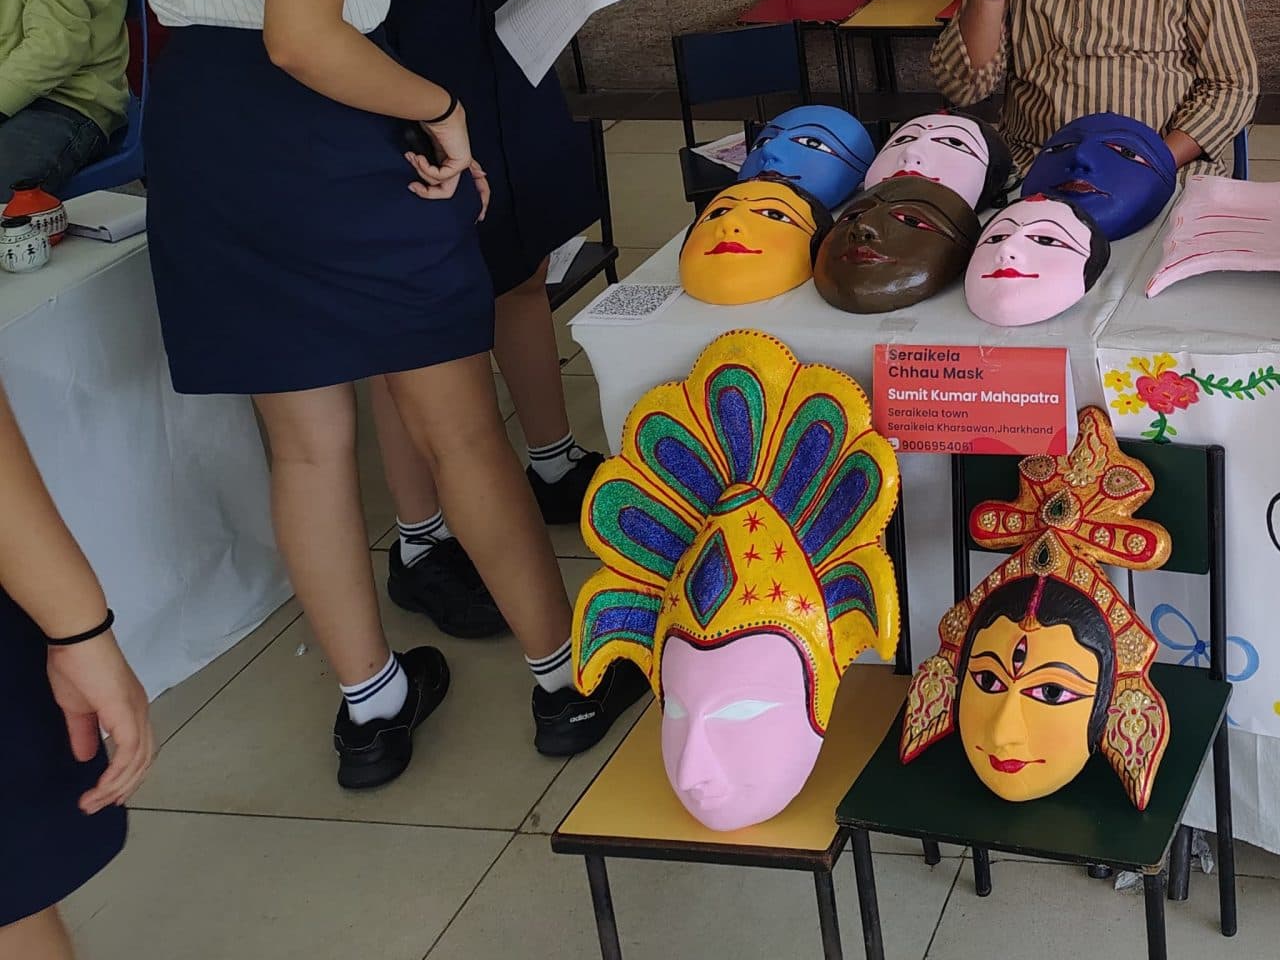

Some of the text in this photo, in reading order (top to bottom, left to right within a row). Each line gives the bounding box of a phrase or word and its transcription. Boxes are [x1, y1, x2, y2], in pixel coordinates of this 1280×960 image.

[888, 348, 960, 362] Seraikela
[888, 366, 984, 380] Chhau Mask
[888, 388, 1060, 406] Sumit Kumar Mahapatra
[888, 407, 969, 418] Seraikela town
[888, 422, 934, 432] Seraikela
